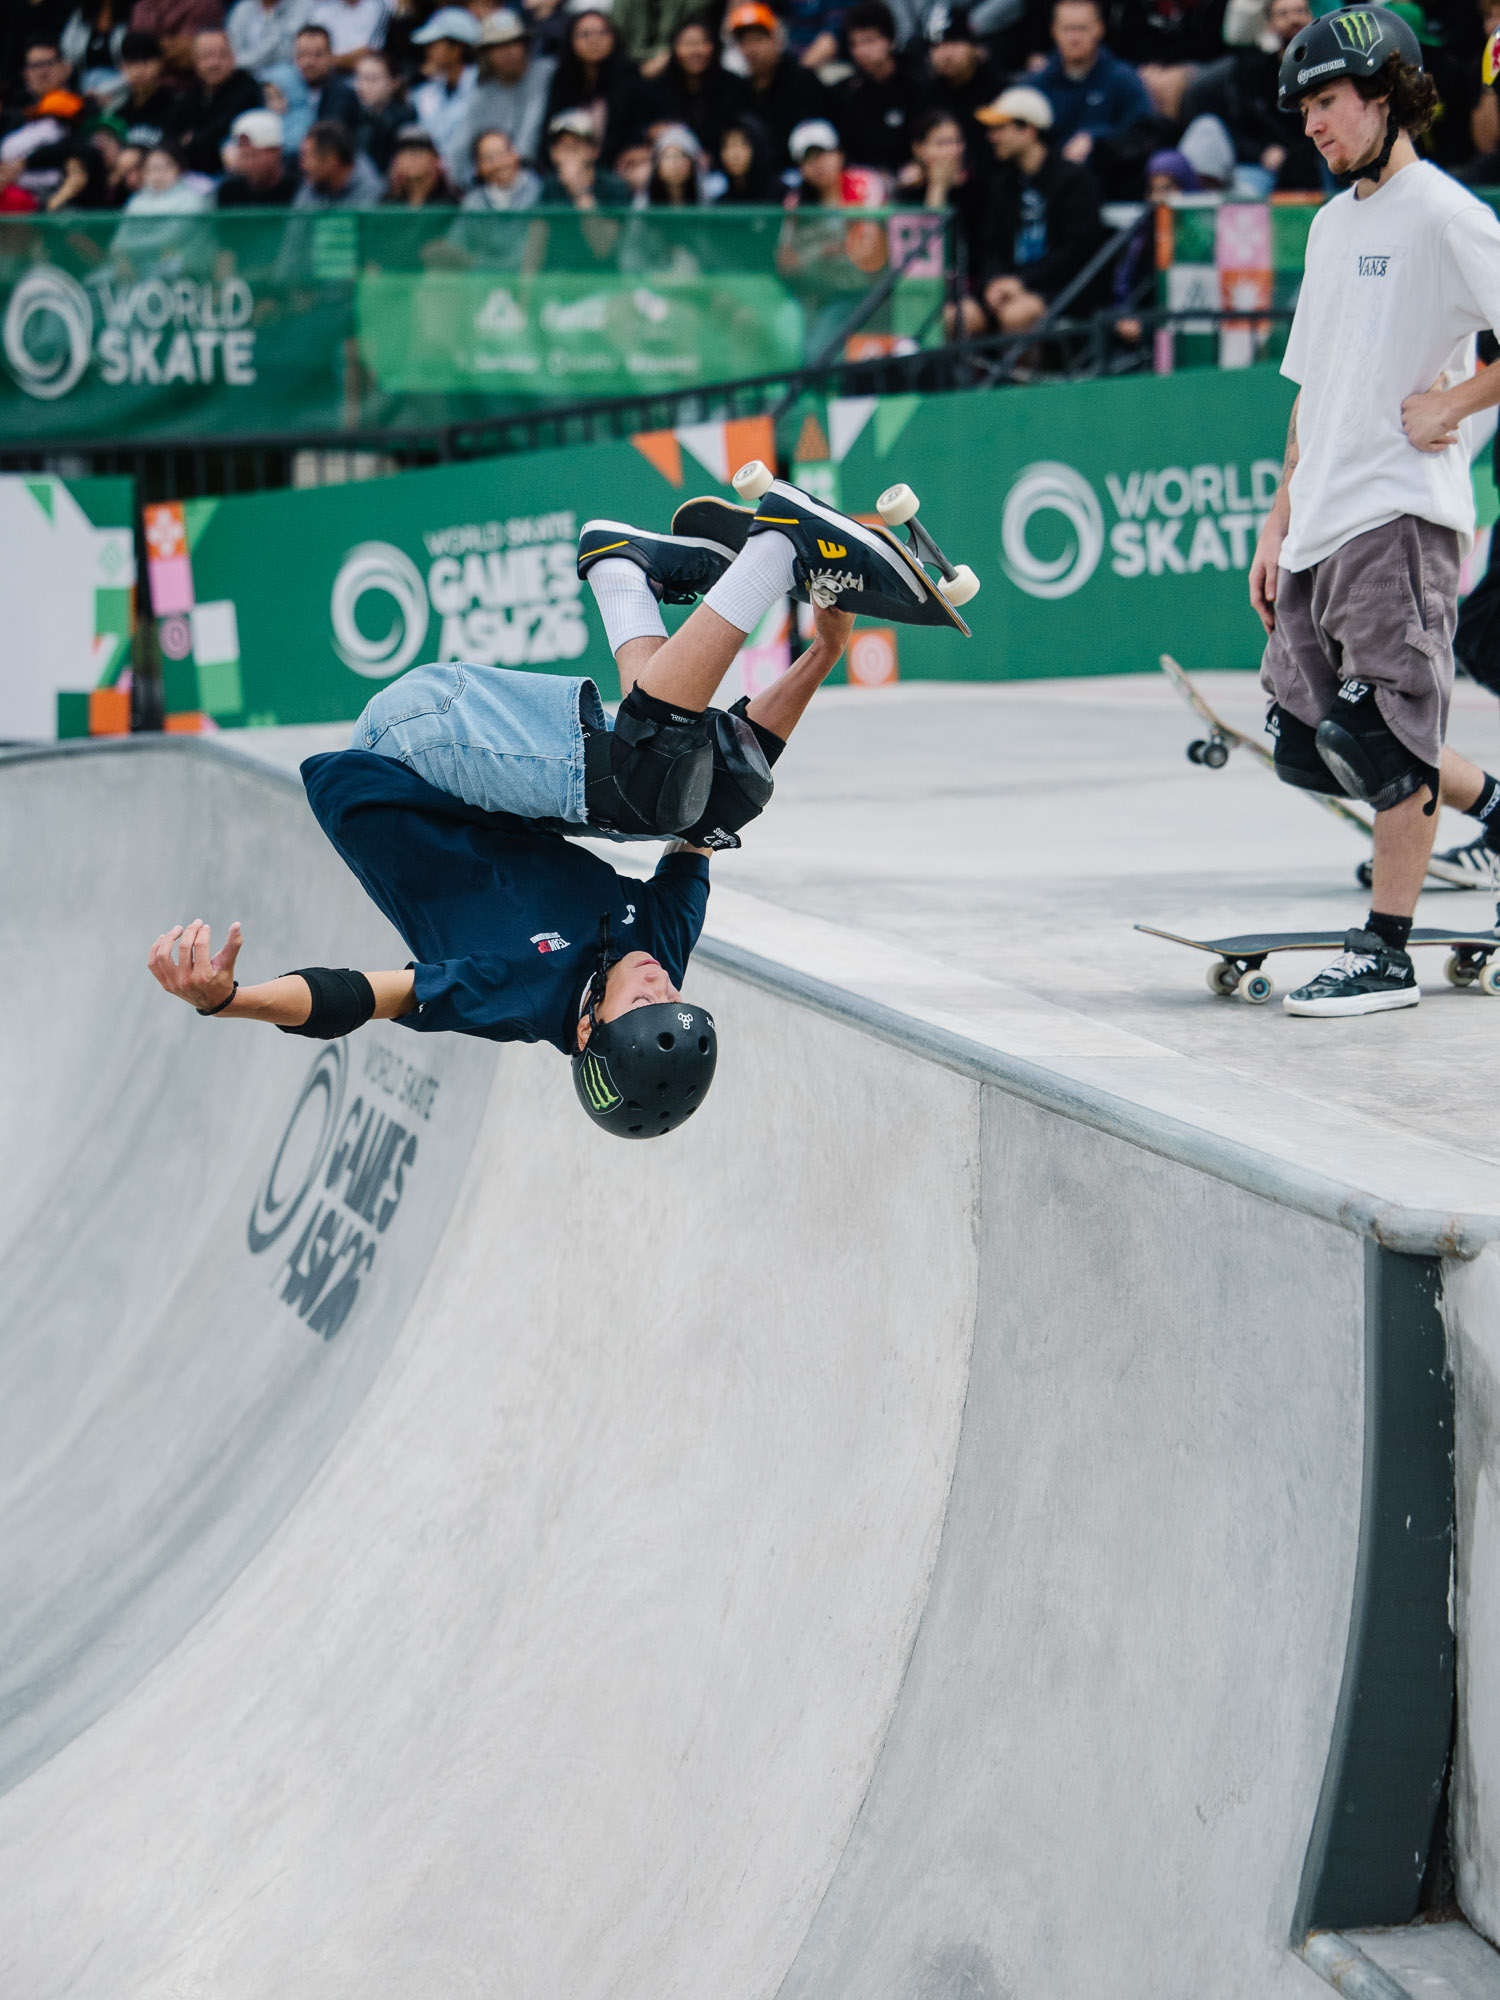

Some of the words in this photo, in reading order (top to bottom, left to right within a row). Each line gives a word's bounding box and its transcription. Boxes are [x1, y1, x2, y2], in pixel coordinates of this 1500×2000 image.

[1357, 256, 1391, 277] VANS
[98, 276, 255, 329] WORLD
[100, 330, 257, 386] SKATE
[1104, 460, 1283, 519] WORLD
[427, 542, 582, 617] GAMES
